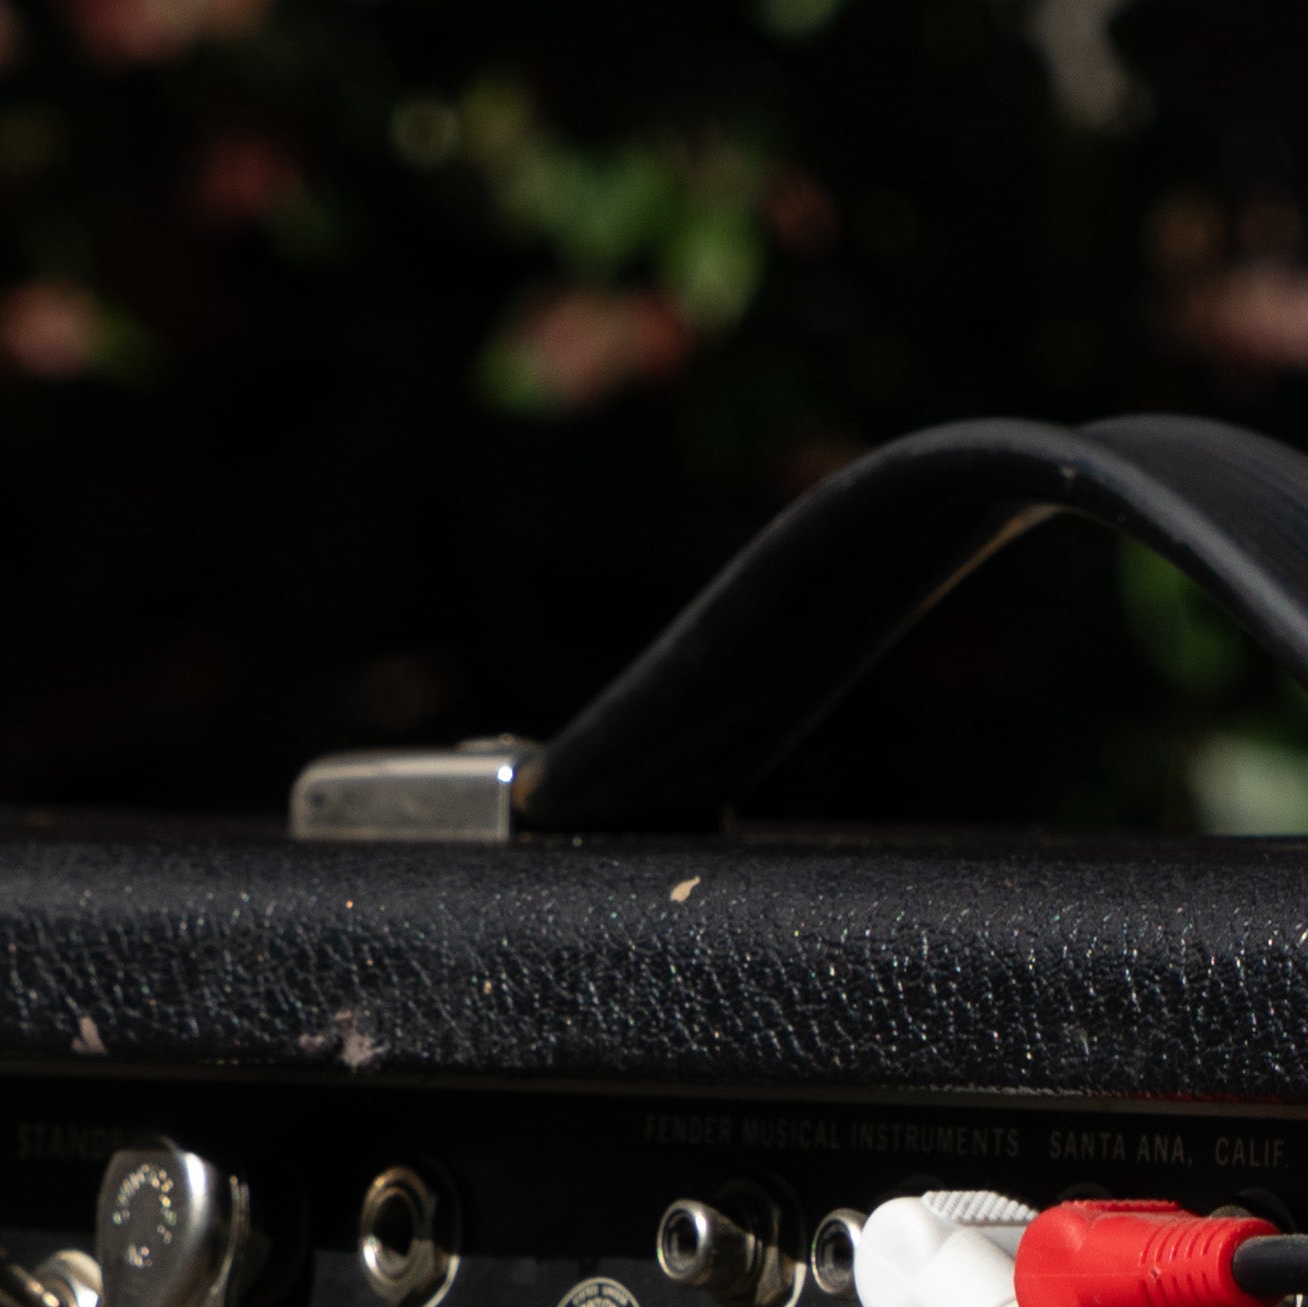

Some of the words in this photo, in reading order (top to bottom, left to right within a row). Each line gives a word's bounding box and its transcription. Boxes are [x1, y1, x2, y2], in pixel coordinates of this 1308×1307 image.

[644, 1115, 732, 1146] FENDER
[740, 1119, 842, 1151] MUSICAL
[849, 1122, 1021, 1157] INSTRUMENTS
[1049, 1131, 1127, 1163] SANTA
[1135, 1133, 1194, 1169] ANA,
[1215, 1136, 1291, 1169] CALIF.
